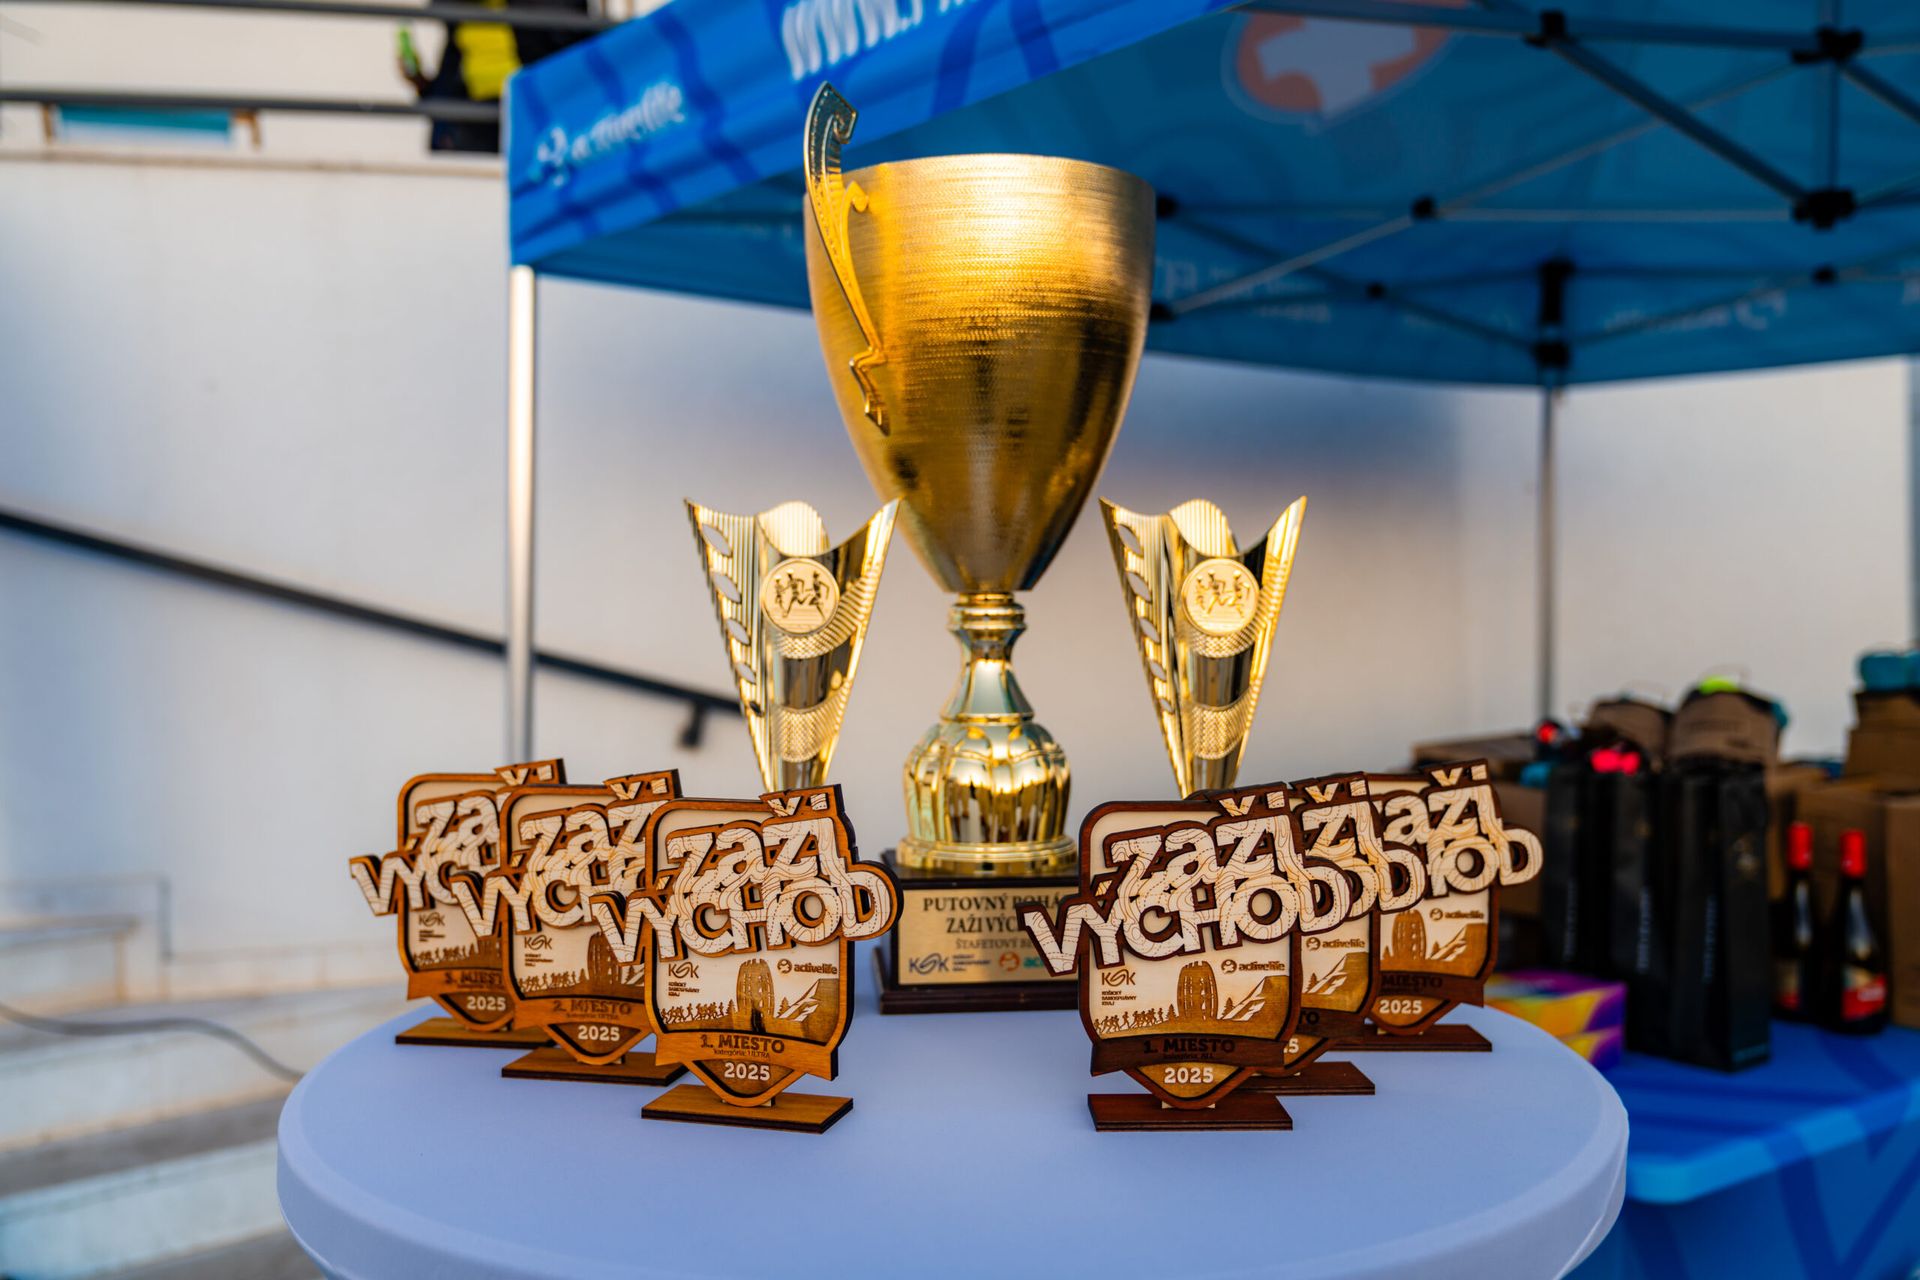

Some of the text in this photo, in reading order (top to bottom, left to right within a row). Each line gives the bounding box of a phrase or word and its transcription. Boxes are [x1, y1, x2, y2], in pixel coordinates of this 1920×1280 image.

[923, 893, 1007, 911] PUTOVNÝ
[467, 996, 506, 1011] 2025
[571, 999, 632, 1016] MIESTO
[1379, 1000, 1423, 1014] 2025
[578, 1025, 620, 1041] 2025
[700, 1034, 785, 1054] 1. MIESTO
[1143, 1038, 1236, 1054] 1. MIESTO
[724, 1061, 771, 1081] 2025
[1164, 1067, 1214, 1084] 2025
